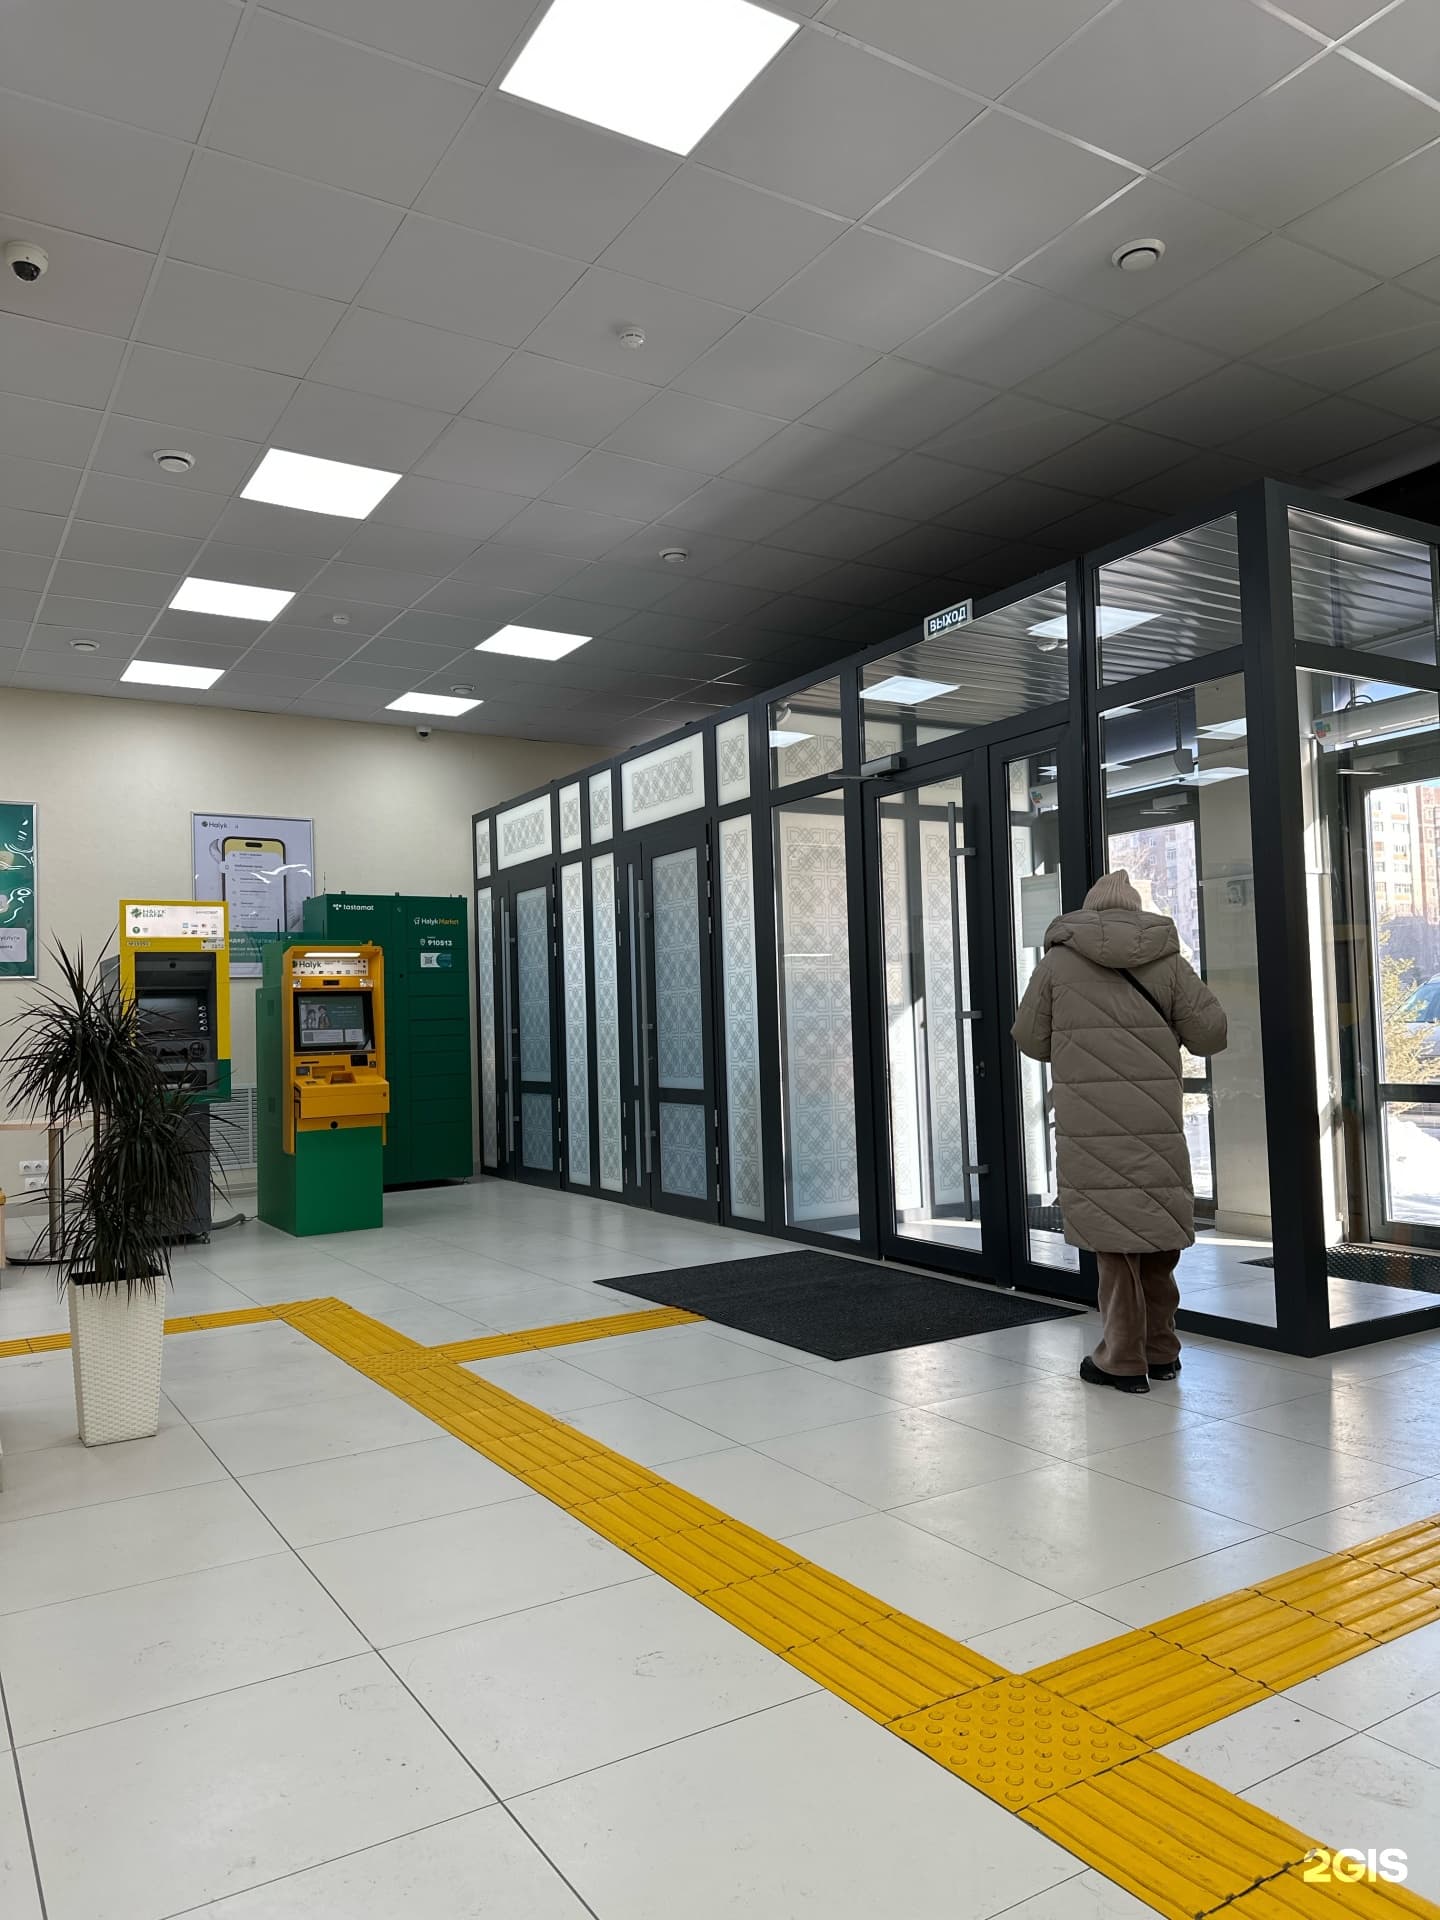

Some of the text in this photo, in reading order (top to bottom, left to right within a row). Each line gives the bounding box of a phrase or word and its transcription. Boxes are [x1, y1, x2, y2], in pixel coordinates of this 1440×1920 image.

[929, 607, 967, 632] ВЫХОД
[427, 938, 453, 947] 910513
[299, 960, 322, 969] Halyk
